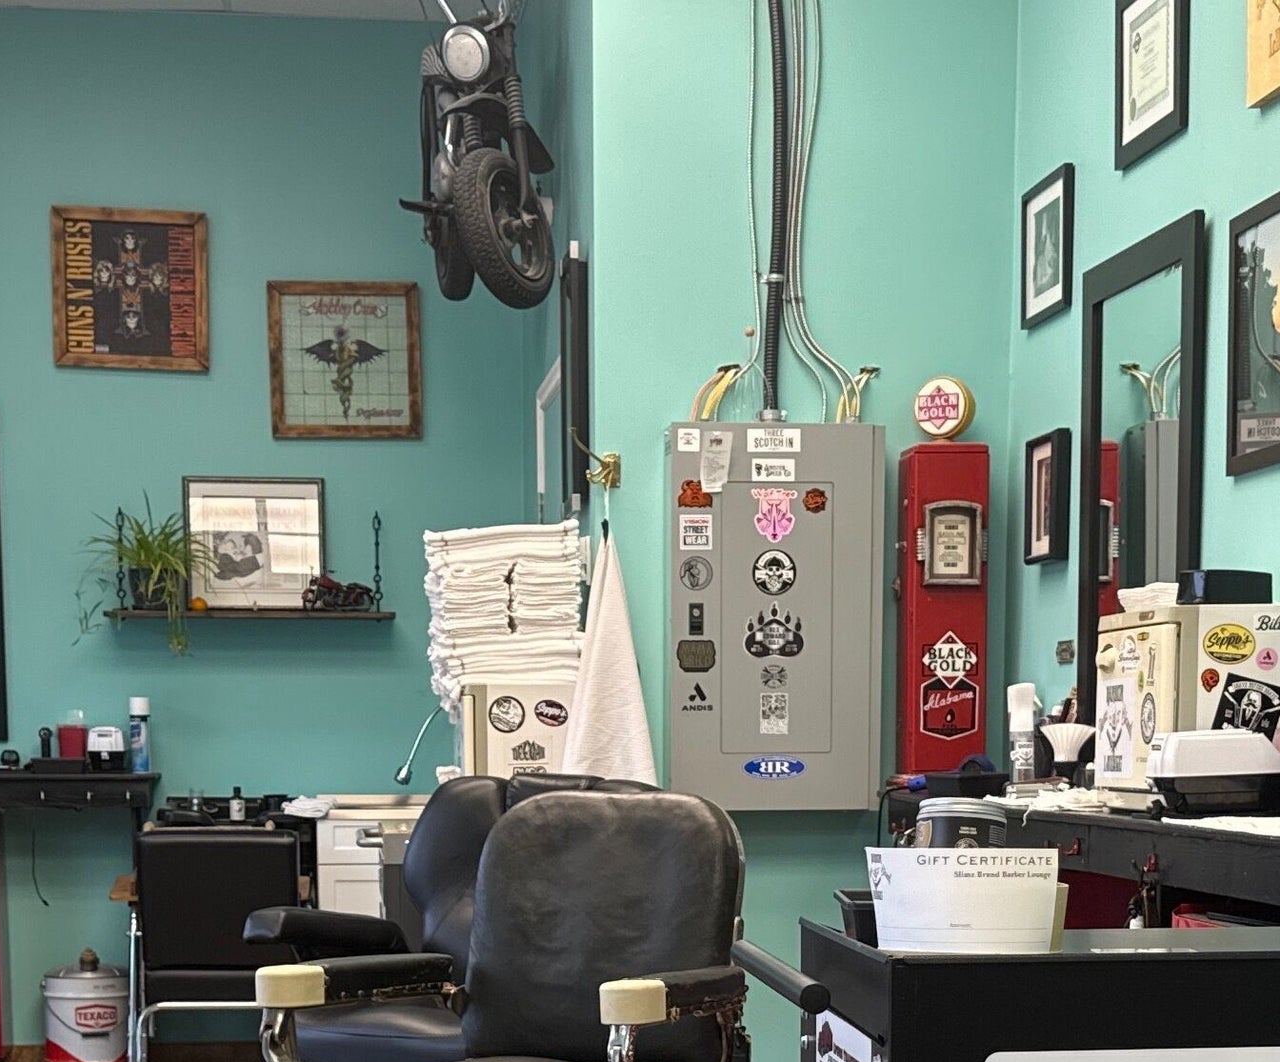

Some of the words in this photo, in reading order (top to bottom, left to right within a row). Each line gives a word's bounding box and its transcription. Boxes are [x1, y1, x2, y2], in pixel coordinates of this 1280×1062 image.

[65, 221, 93, 280] ROSES
[67, 305, 95, 353] GUNS
[922, 407, 953, 418] GOLD
[754, 437, 783, 448] SCOTCH
[785, 437, 794, 448] IN
[683, 526, 709, 534] STREET
[685, 536, 707, 545] WEAR
[928, 648, 972, 660] BLACK
[928, 660, 973, 672] GOLD
[923, 690, 974, 711] Alabama
[916, 855, 950, 866] GIFT
[956, 855, 1053, 866] CERTIFICATE
[77, 1011, 116, 1021] TEXACO
